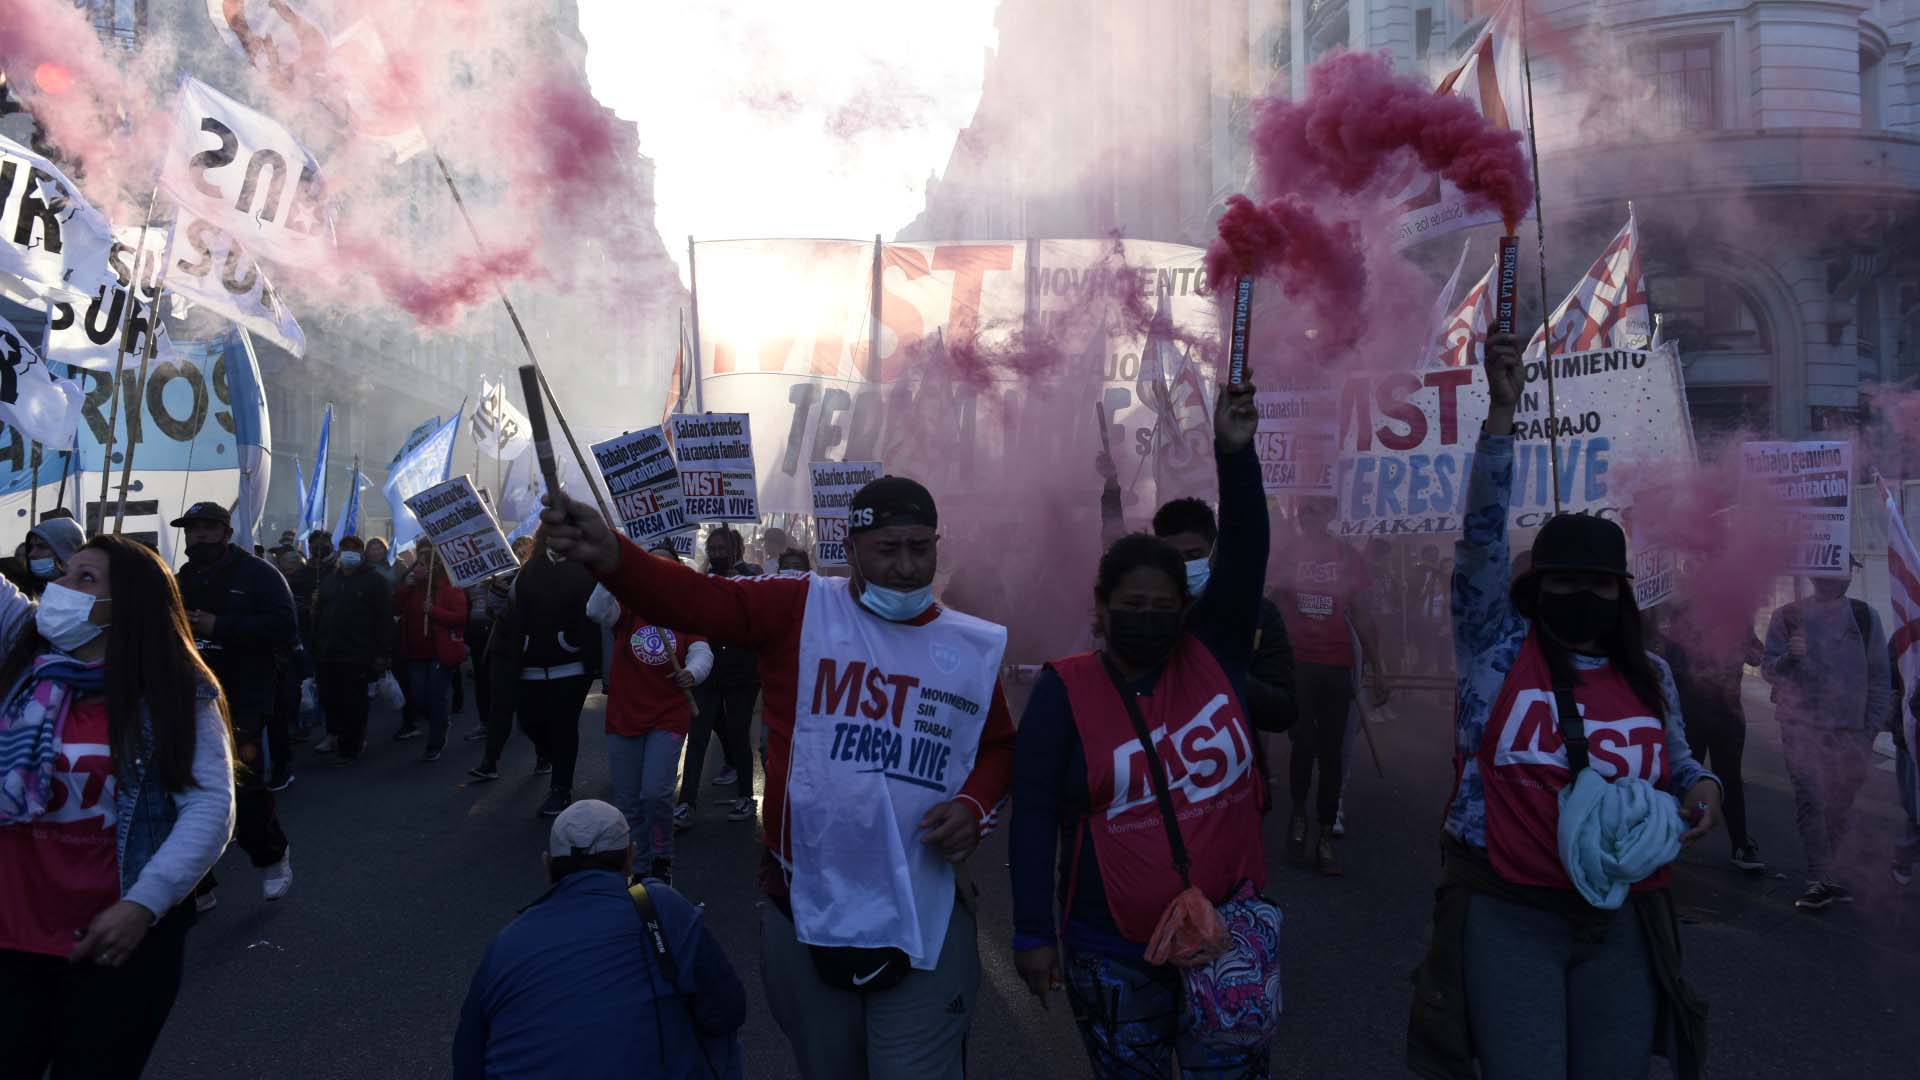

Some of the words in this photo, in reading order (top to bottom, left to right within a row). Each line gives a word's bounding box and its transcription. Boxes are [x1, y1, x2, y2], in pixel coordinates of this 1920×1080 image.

[1502, 247, 1516, 298] BENGALA
[1236, 282, 1249, 331] BENGALA
[1501, 303, 1512, 319] DE
[1234, 336, 1244, 350] DE
[1231, 353, 1243, 384] HUMO
[1523, 352, 1646, 385] OVIMIENTO
[1516, 391, 1538, 414] IN
[675, 419, 711, 439] Salarios
[710, 417, 742, 436] acordes
[1514, 411, 1600, 441] RABAJO
[596, 444, 629, 470] Trabajo
[627, 433, 662, 461] genuino
[681, 443, 691, 461] la
[690, 442, 719, 460] canasta
[719, 440, 750, 459] familiar
[1744, 449, 1789, 473] Trabajo
[1791, 445, 1841, 473] genuino
[682, 472, 724, 496] MST
[813, 468, 845, 487] Salarios
[615, 489, 660, 520] MST
[685, 498, 725, 515] TERESA
[729, 498, 754, 516] VIVE
[626, 514, 665, 539] TERESA
[666, 506, 684, 527] VIV
[1340, 516, 1463, 535] MAKAL
[440, 536, 480, 565] MST
[453, 554, 489, 581] TERESA
[487, 548, 511, 568] VIVE
[819, 543, 847, 560] TERE
[810, 658, 920, 729] MST
[920, 688, 980, 716] MOVIMIENTO
[917, 703, 937, 718] SIN
[830, 723, 902, 769] TERESA
[908, 737, 950, 782] VIVE
